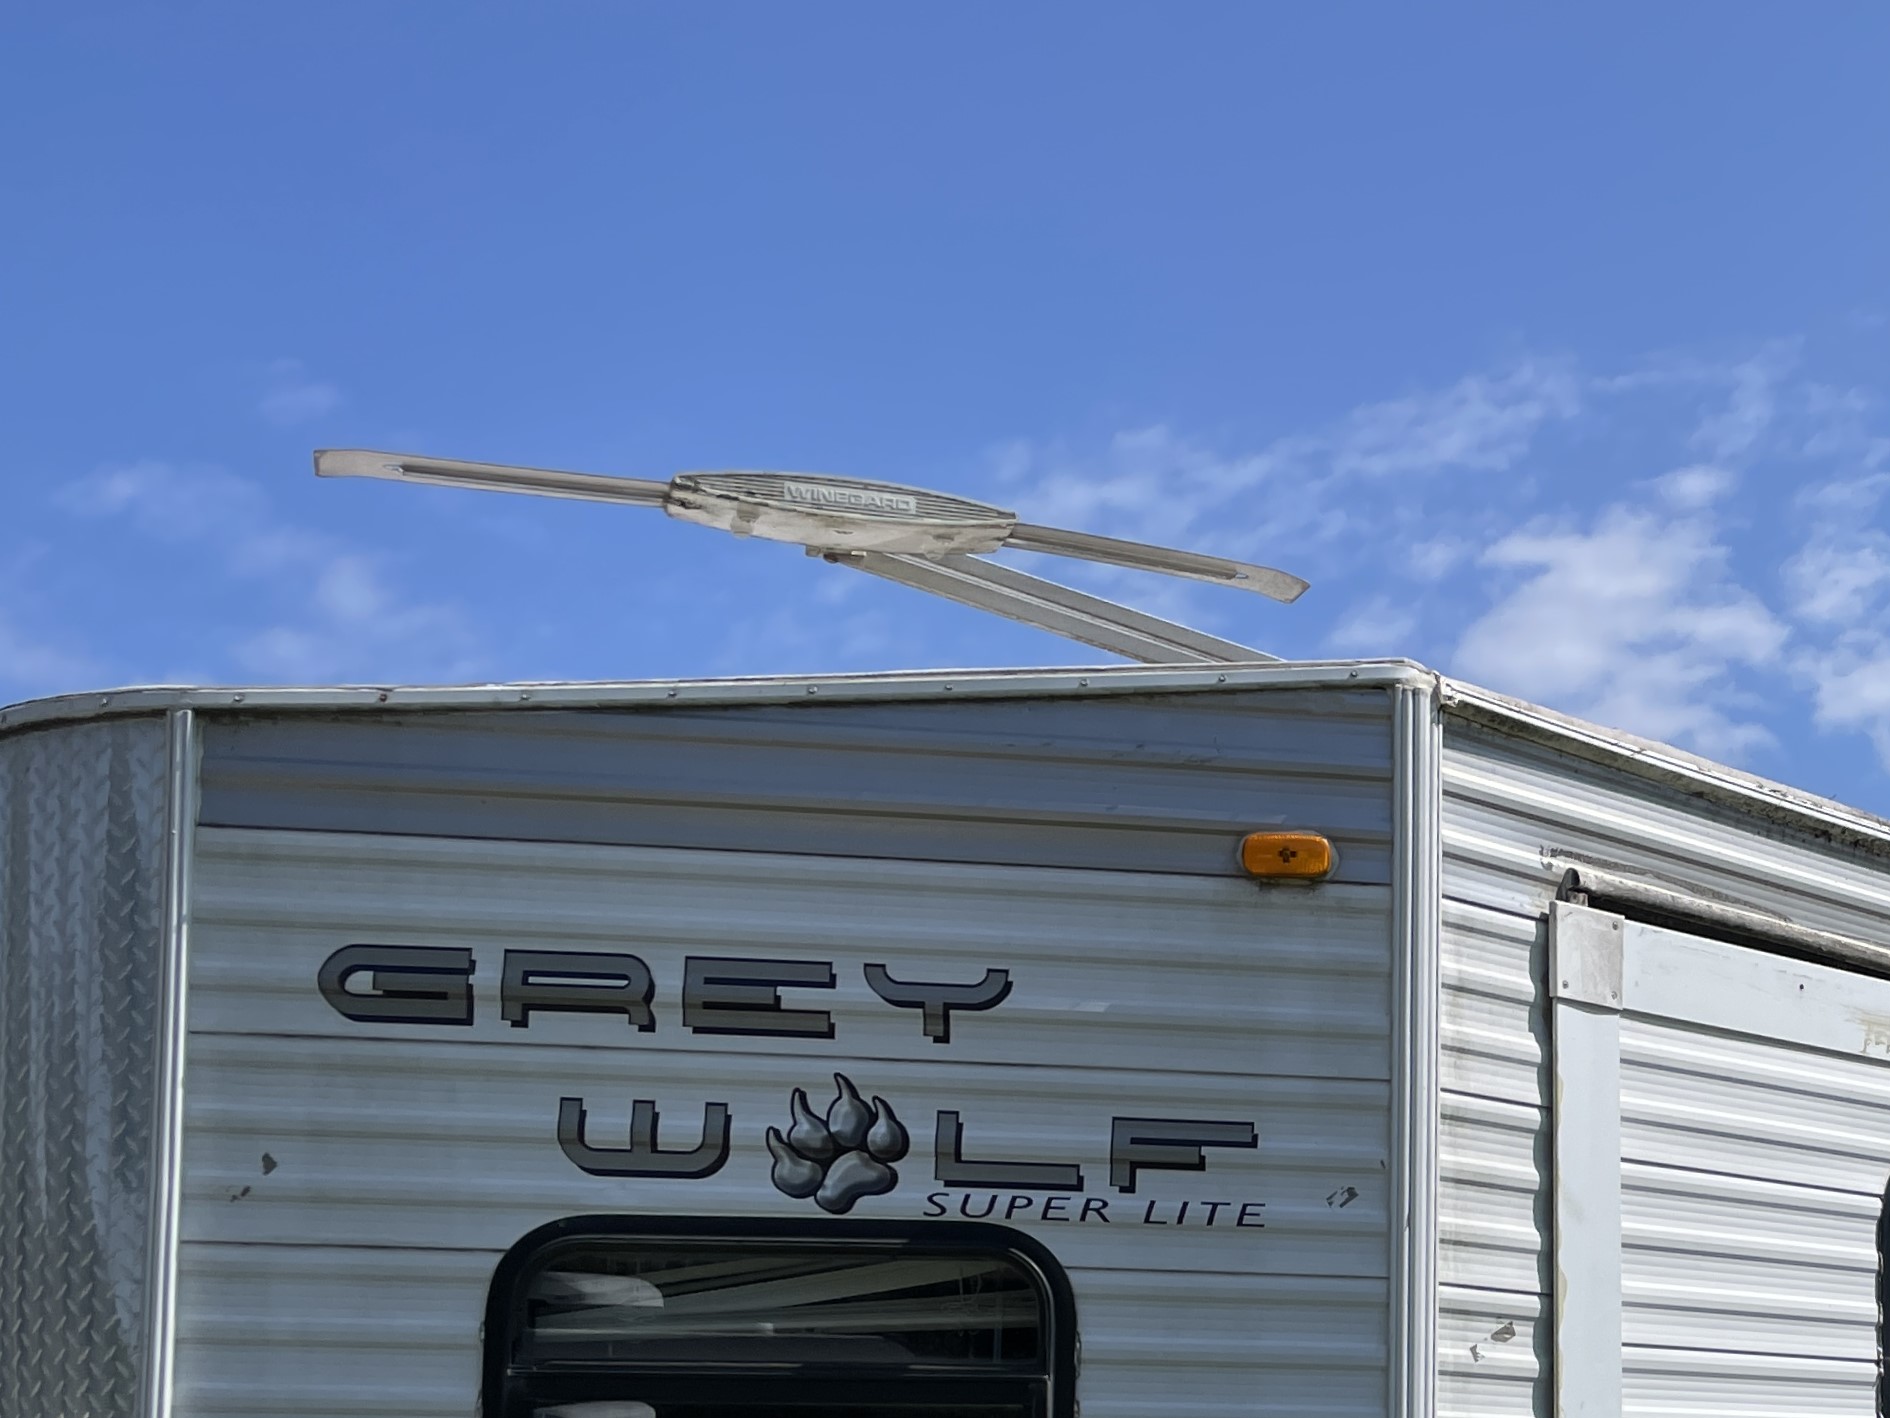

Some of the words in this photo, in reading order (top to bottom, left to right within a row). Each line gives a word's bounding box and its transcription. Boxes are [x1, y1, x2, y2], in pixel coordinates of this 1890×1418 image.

[786, 484, 912, 512] WINEGARD
[317, 943, 1014, 1044] GREY
[556, 1096, 1259, 1194] WLF
[923, 1192, 1111, 1224] SUPER
[1143, 1200, 1267, 1229] LITE
